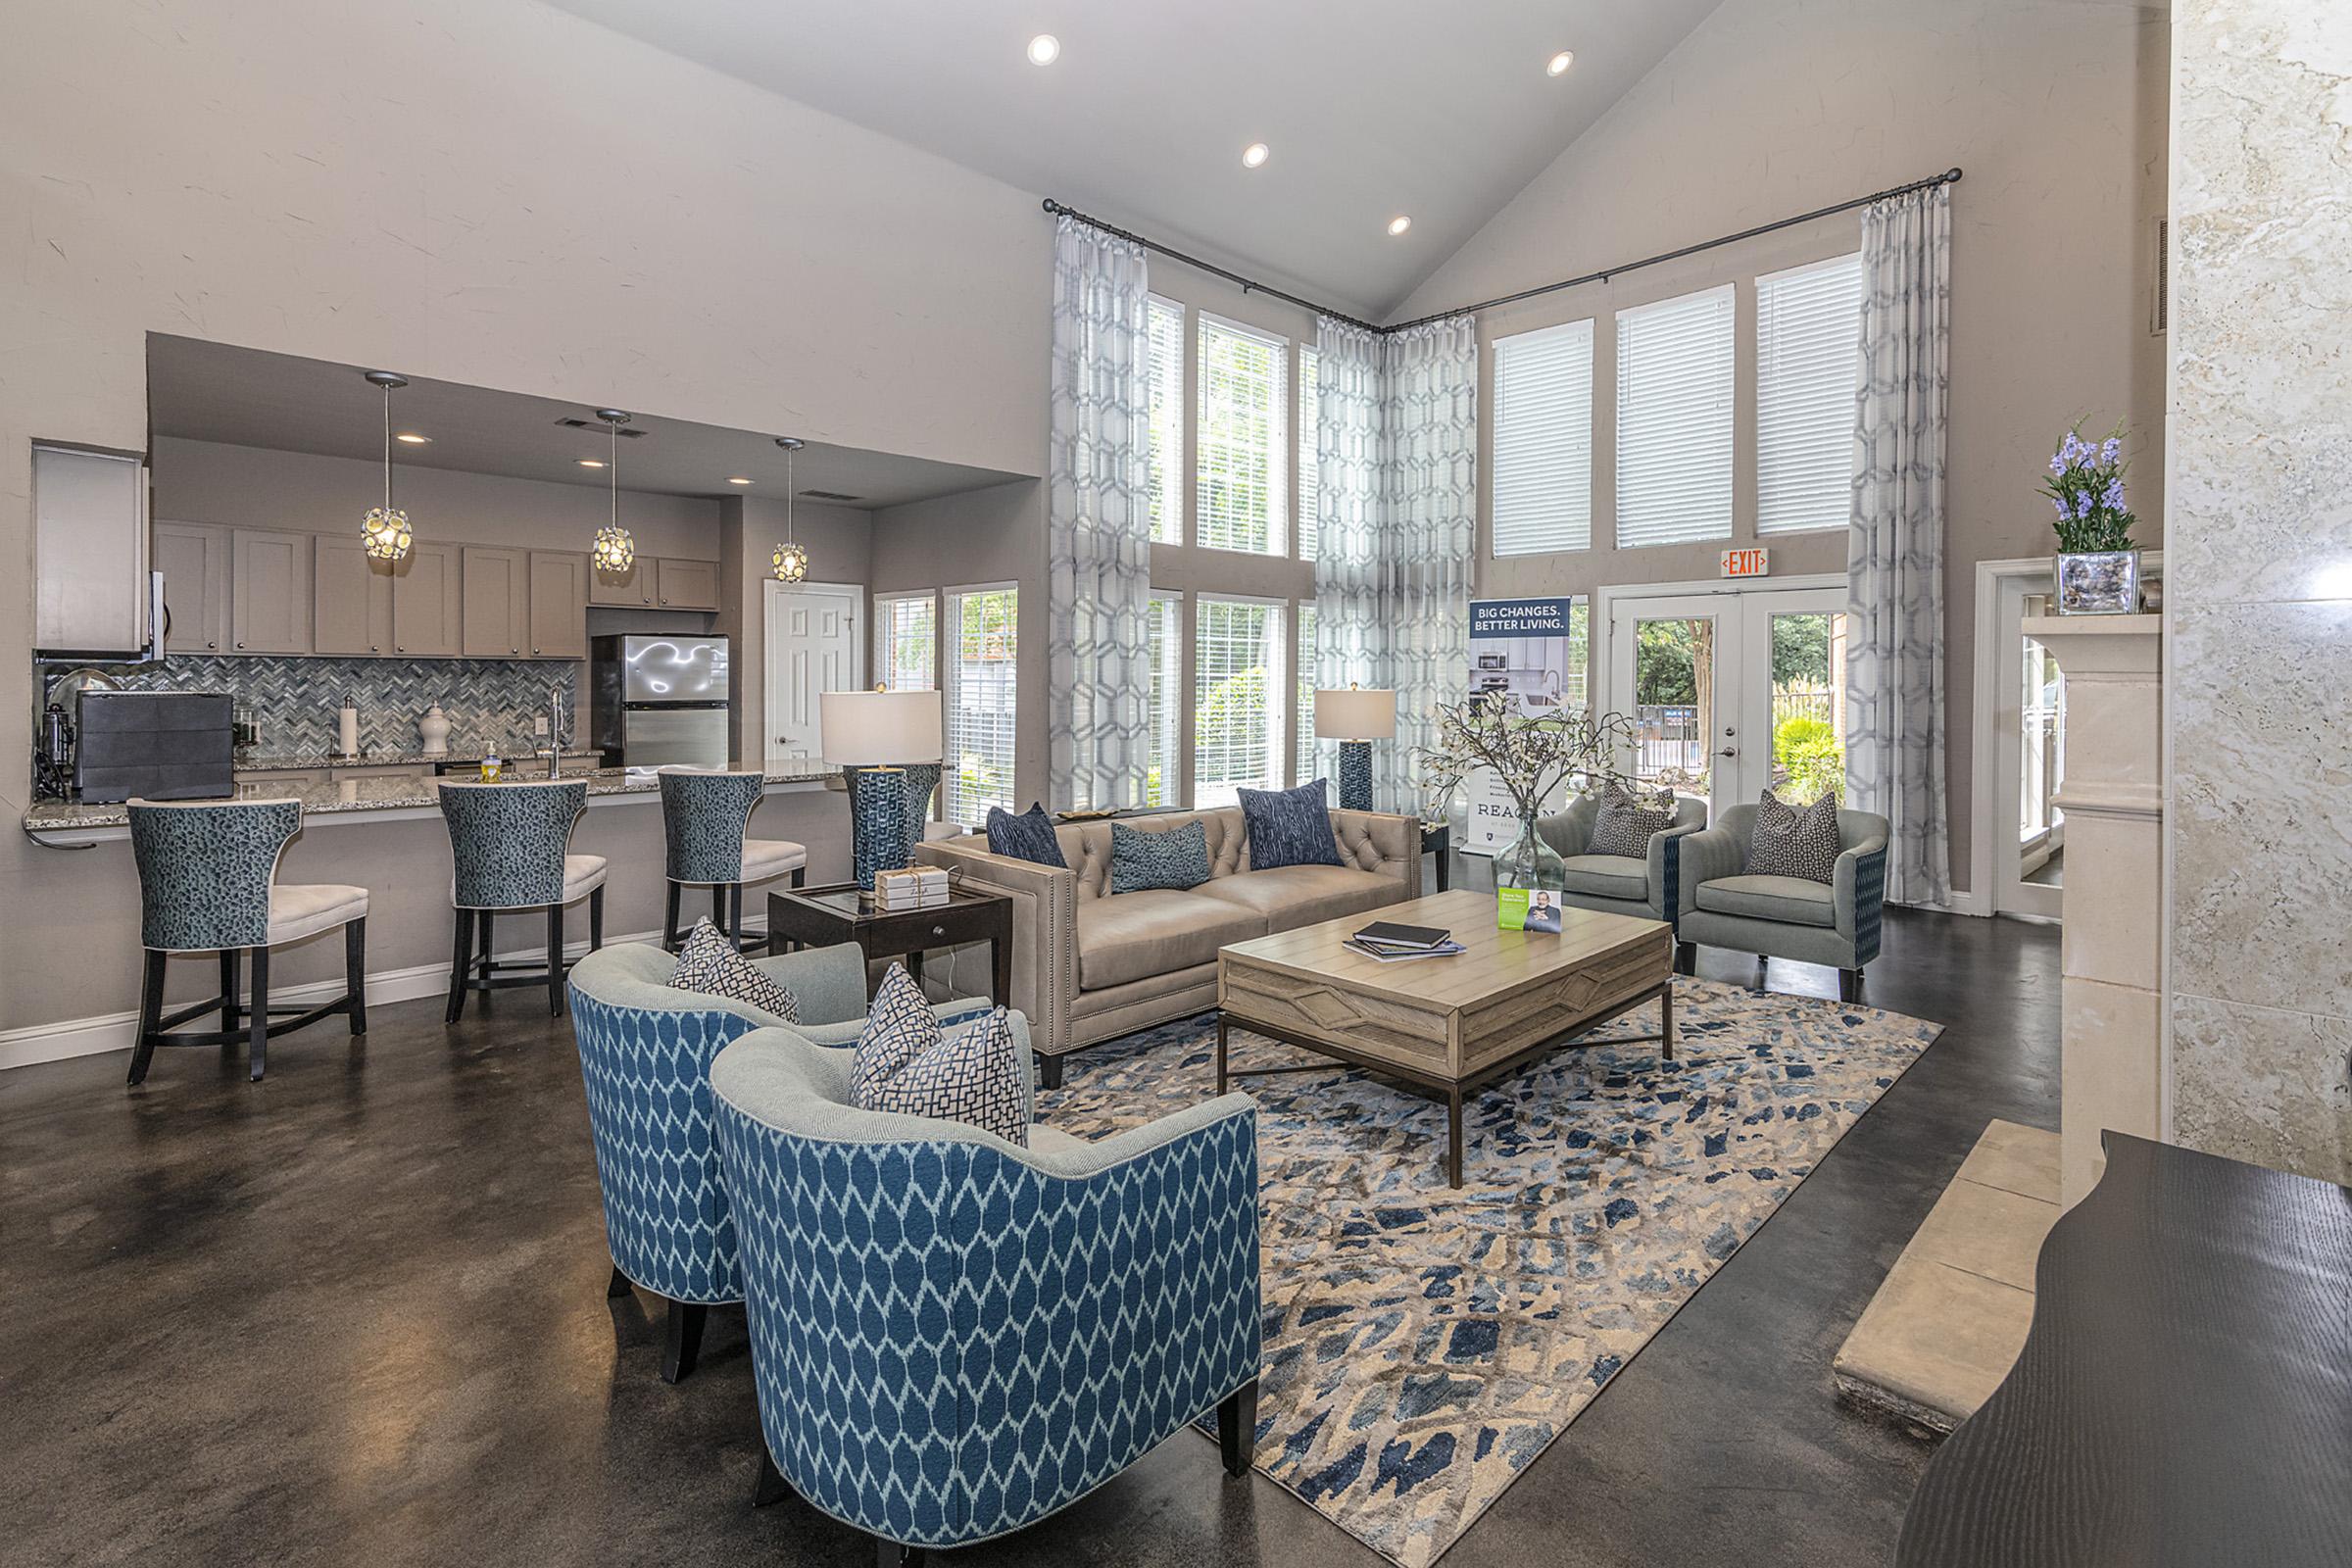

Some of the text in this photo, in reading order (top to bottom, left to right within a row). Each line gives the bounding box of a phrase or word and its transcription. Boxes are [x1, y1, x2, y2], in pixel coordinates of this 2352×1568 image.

[1729, 550, 1761, 574] EXIT
[1478, 605, 1561, 618] BIG CHANGES.
[1475, 618, 1564, 631] BETTER LIVING.
